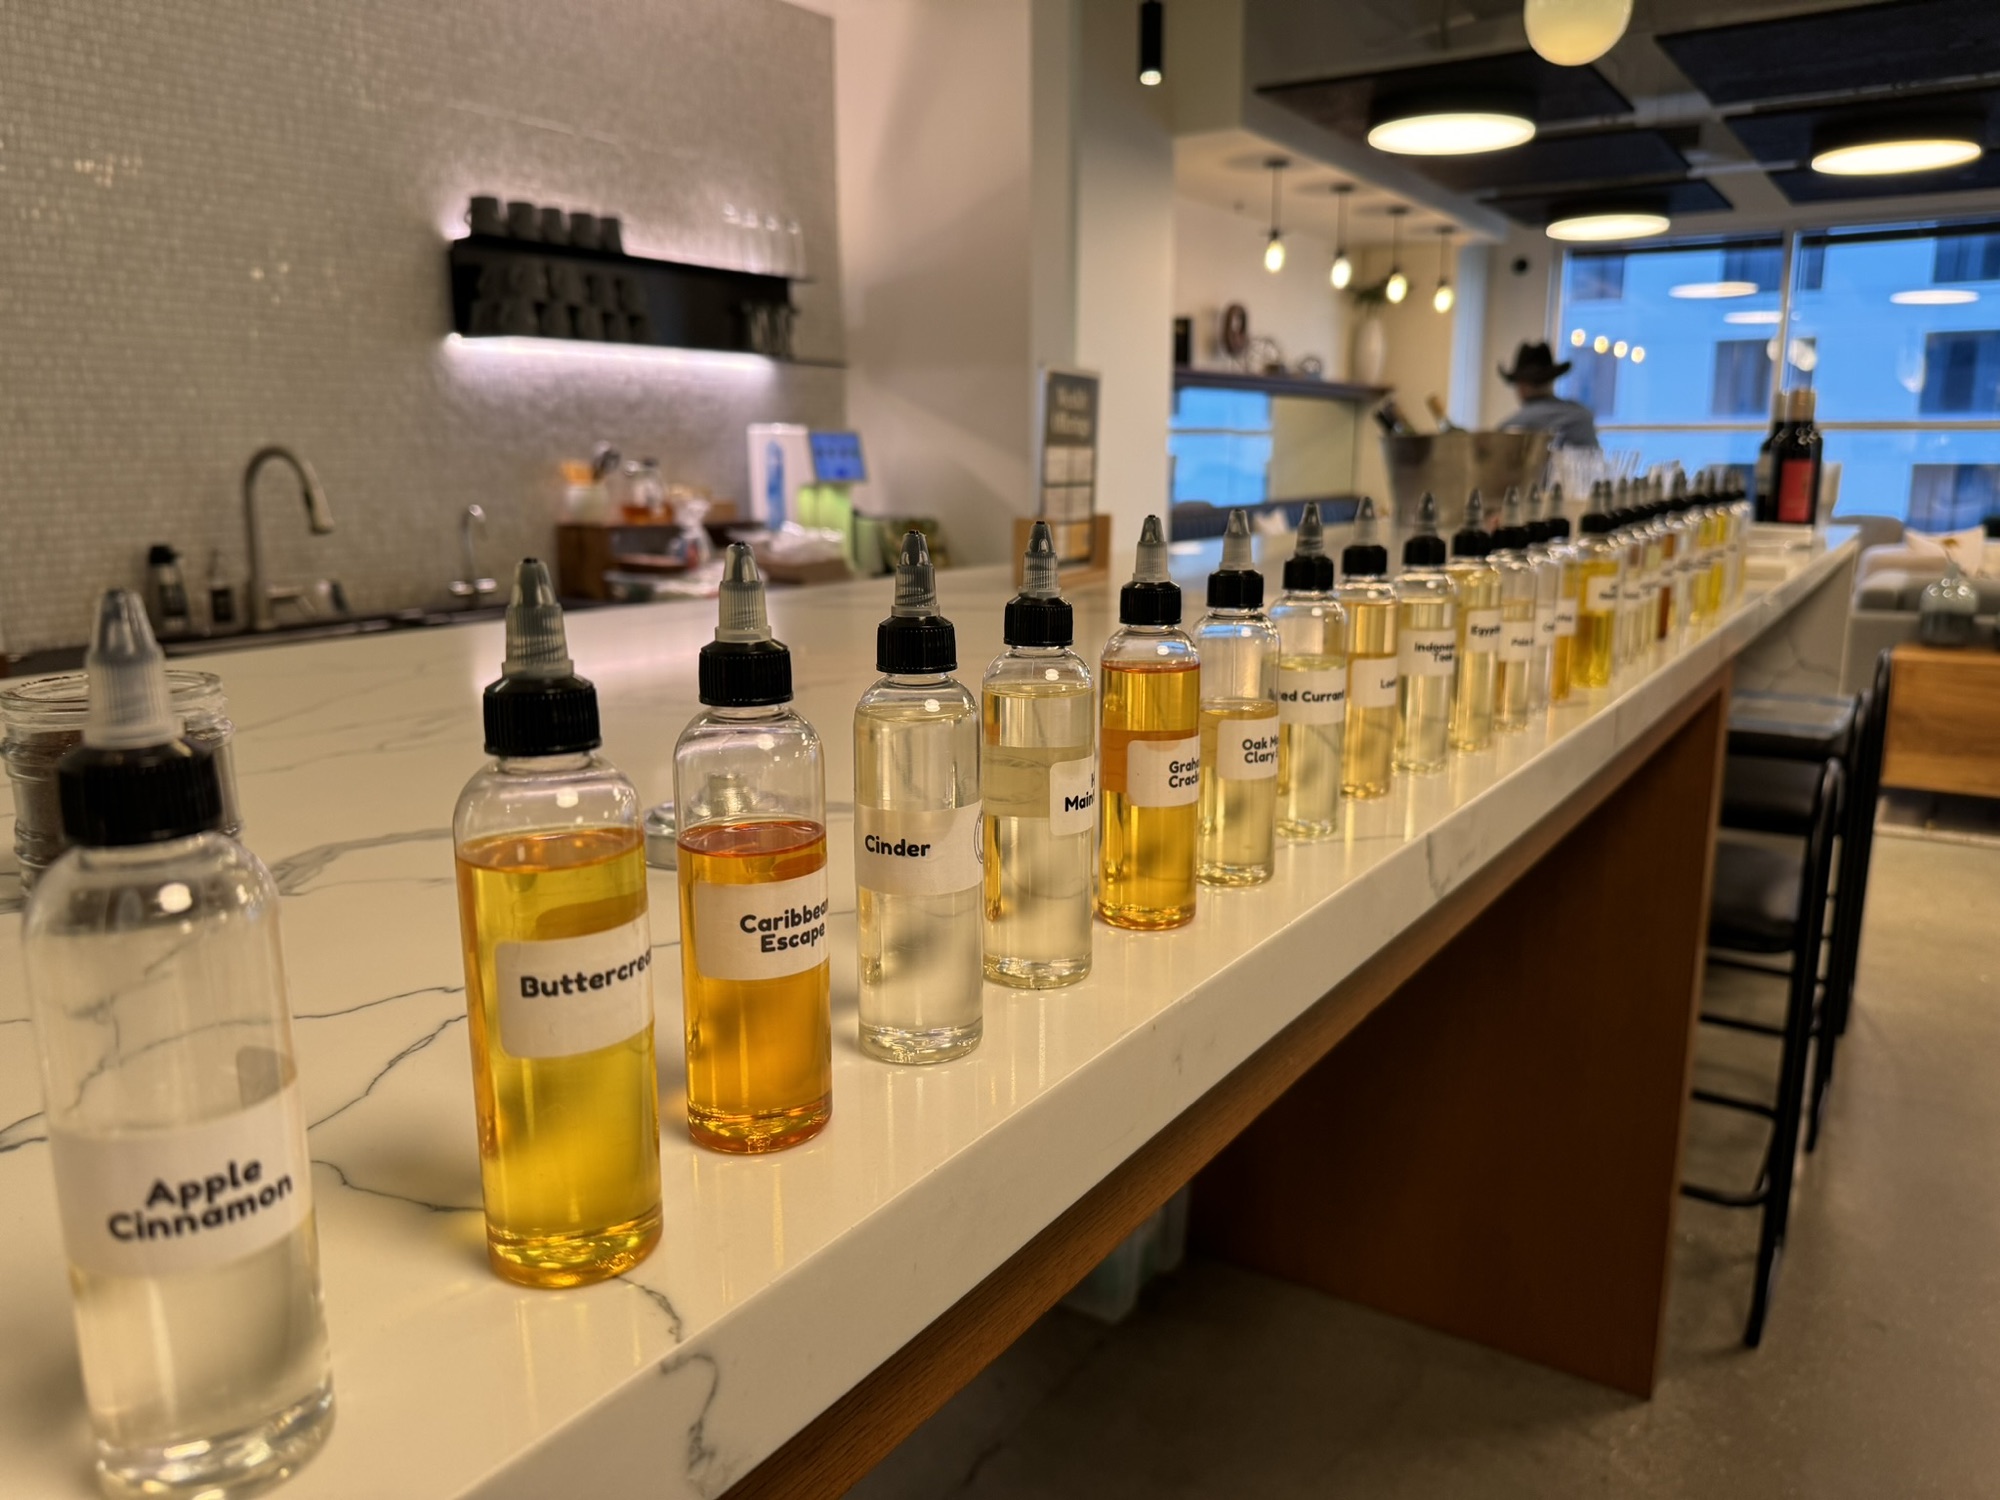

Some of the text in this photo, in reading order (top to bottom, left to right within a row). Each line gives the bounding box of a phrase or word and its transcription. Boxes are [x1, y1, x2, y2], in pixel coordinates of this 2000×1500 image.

[1242, 737, 1267, 750] Oak
[1244, 750, 1274, 764] Clary
[865, 834, 930, 857] Cinder
[761, 923, 824, 953] Escape
[146, 1160, 262, 1209] Apple
[108, 1174, 292, 1242] Cinnamon
